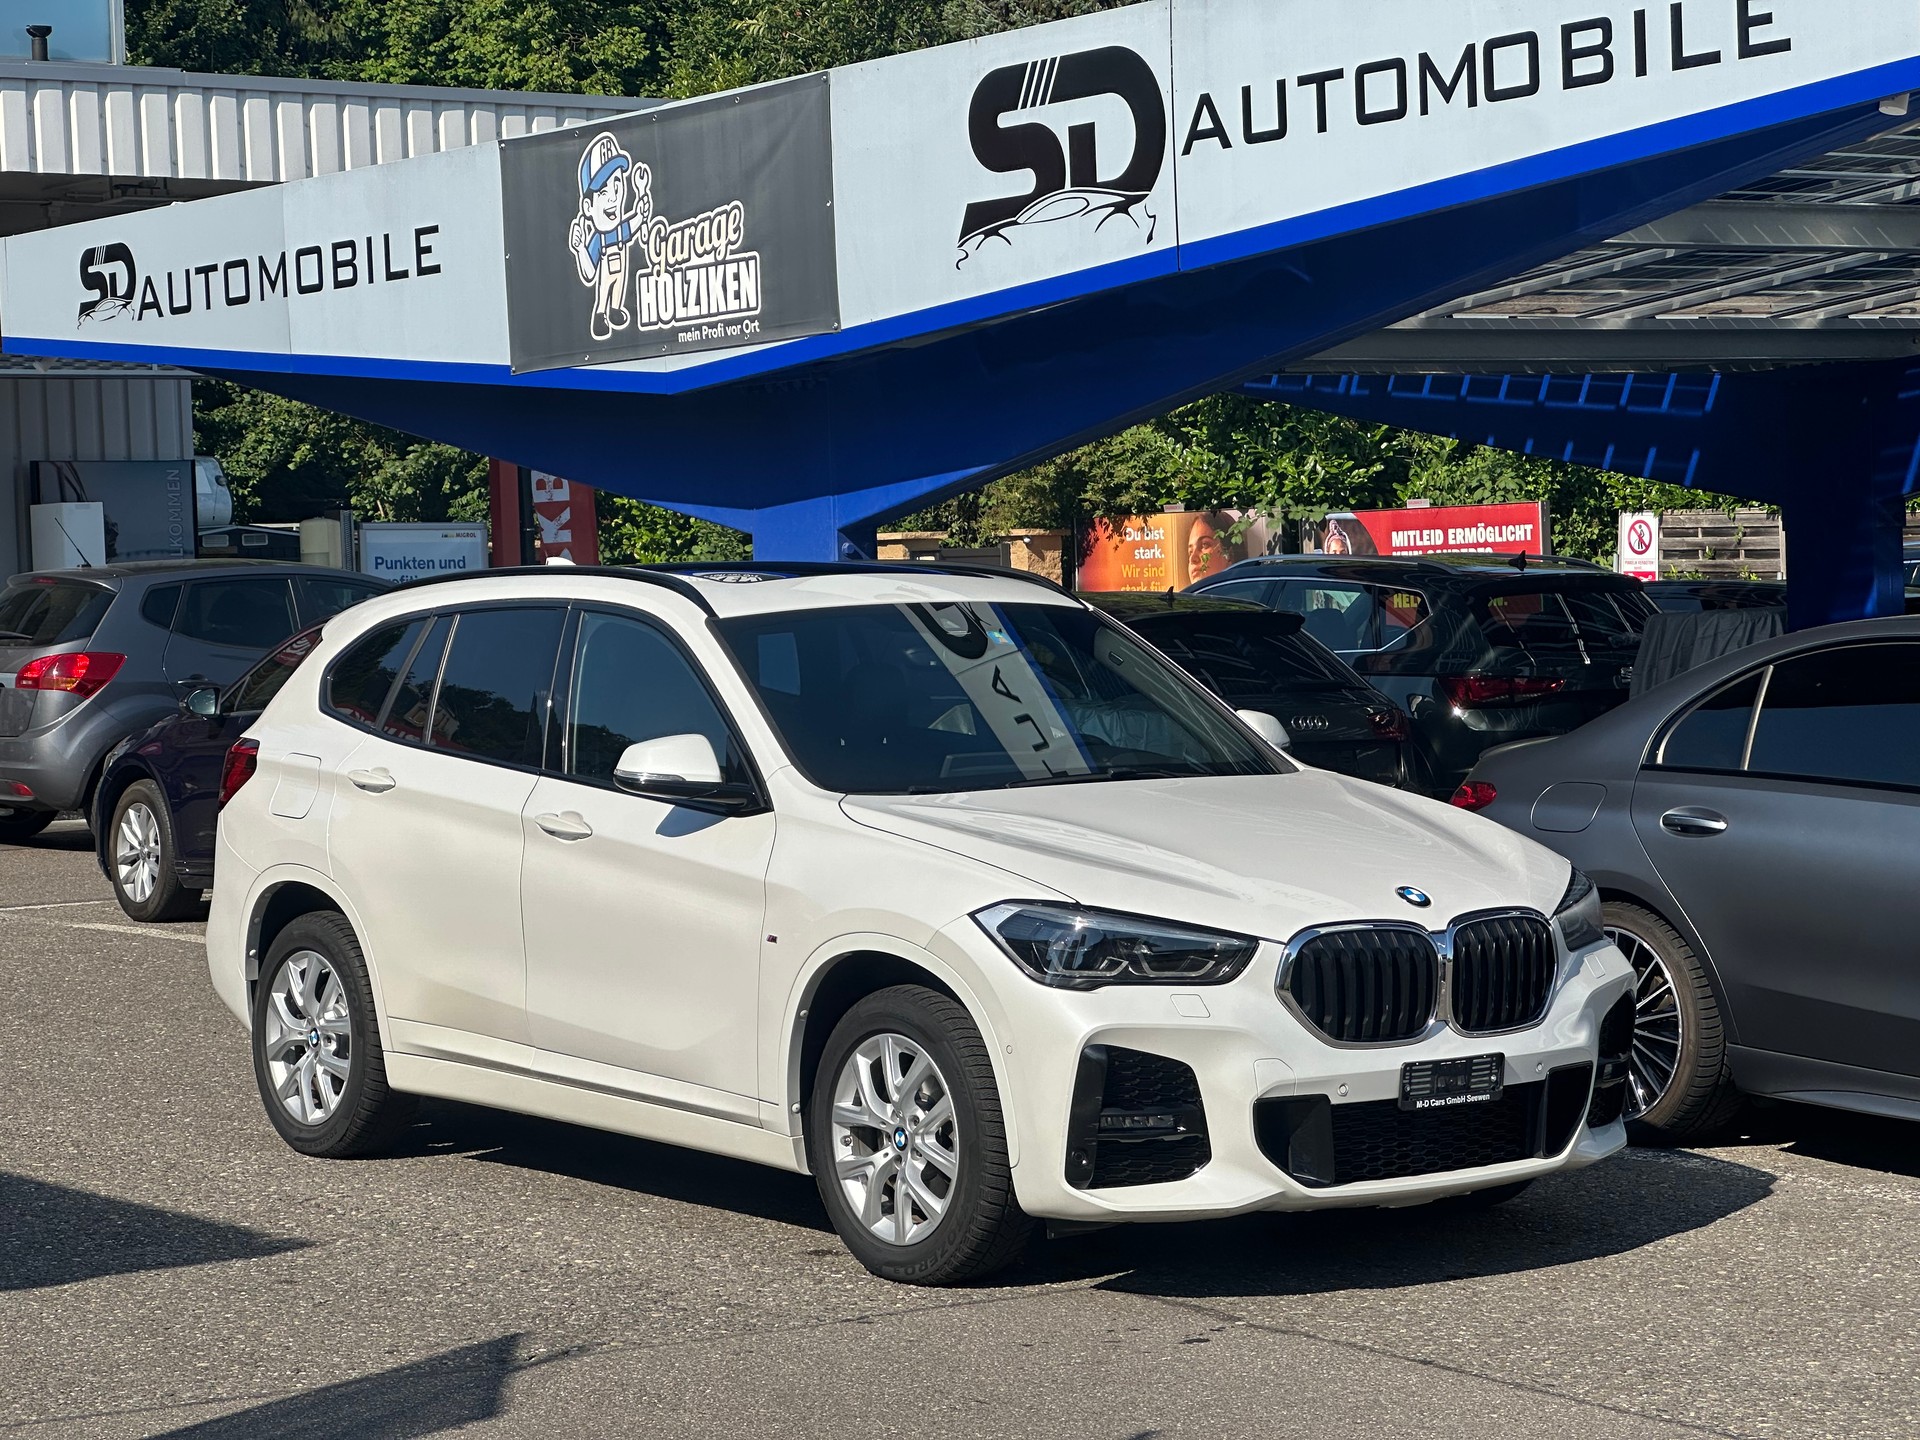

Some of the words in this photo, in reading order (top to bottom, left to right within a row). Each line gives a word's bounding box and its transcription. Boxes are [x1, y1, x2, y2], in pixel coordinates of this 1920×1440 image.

[1181, 0, 1792, 156] AUTOMOBILE
[648, 204, 741, 277] Garage
[137, 224, 441, 321] AUTOMOBILE
[639, 258, 758, 323] HOLZIKEN
[678, 327, 701, 343] mein
[702, 324, 725, 341] Profi
[727, 324, 741, 337] vor
[743, 319, 760, 334] Ort
[166, 469, 183, 560] LKOMMEN
[1126, 527, 1141, 541] Du
[1144, 526, 1165, 541] bist
[1391, 528, 1444, 547] MITLEID
[1448, 522, 1533, 545] ERMÖGLICHT
[374, 556, 435, 570] Punkten
[440, 555, 466, 570] und
[1134, 544, 1165, 560] stark.
[1121, 564, 1140, 578] Wir
[1143, 562, 1165, 578] sind
[1393, 593, 1421, 608] HEL
[1430, 1098, 1445, 1107] Cars
[1446, 1095, 1466, 1105] GmbH
